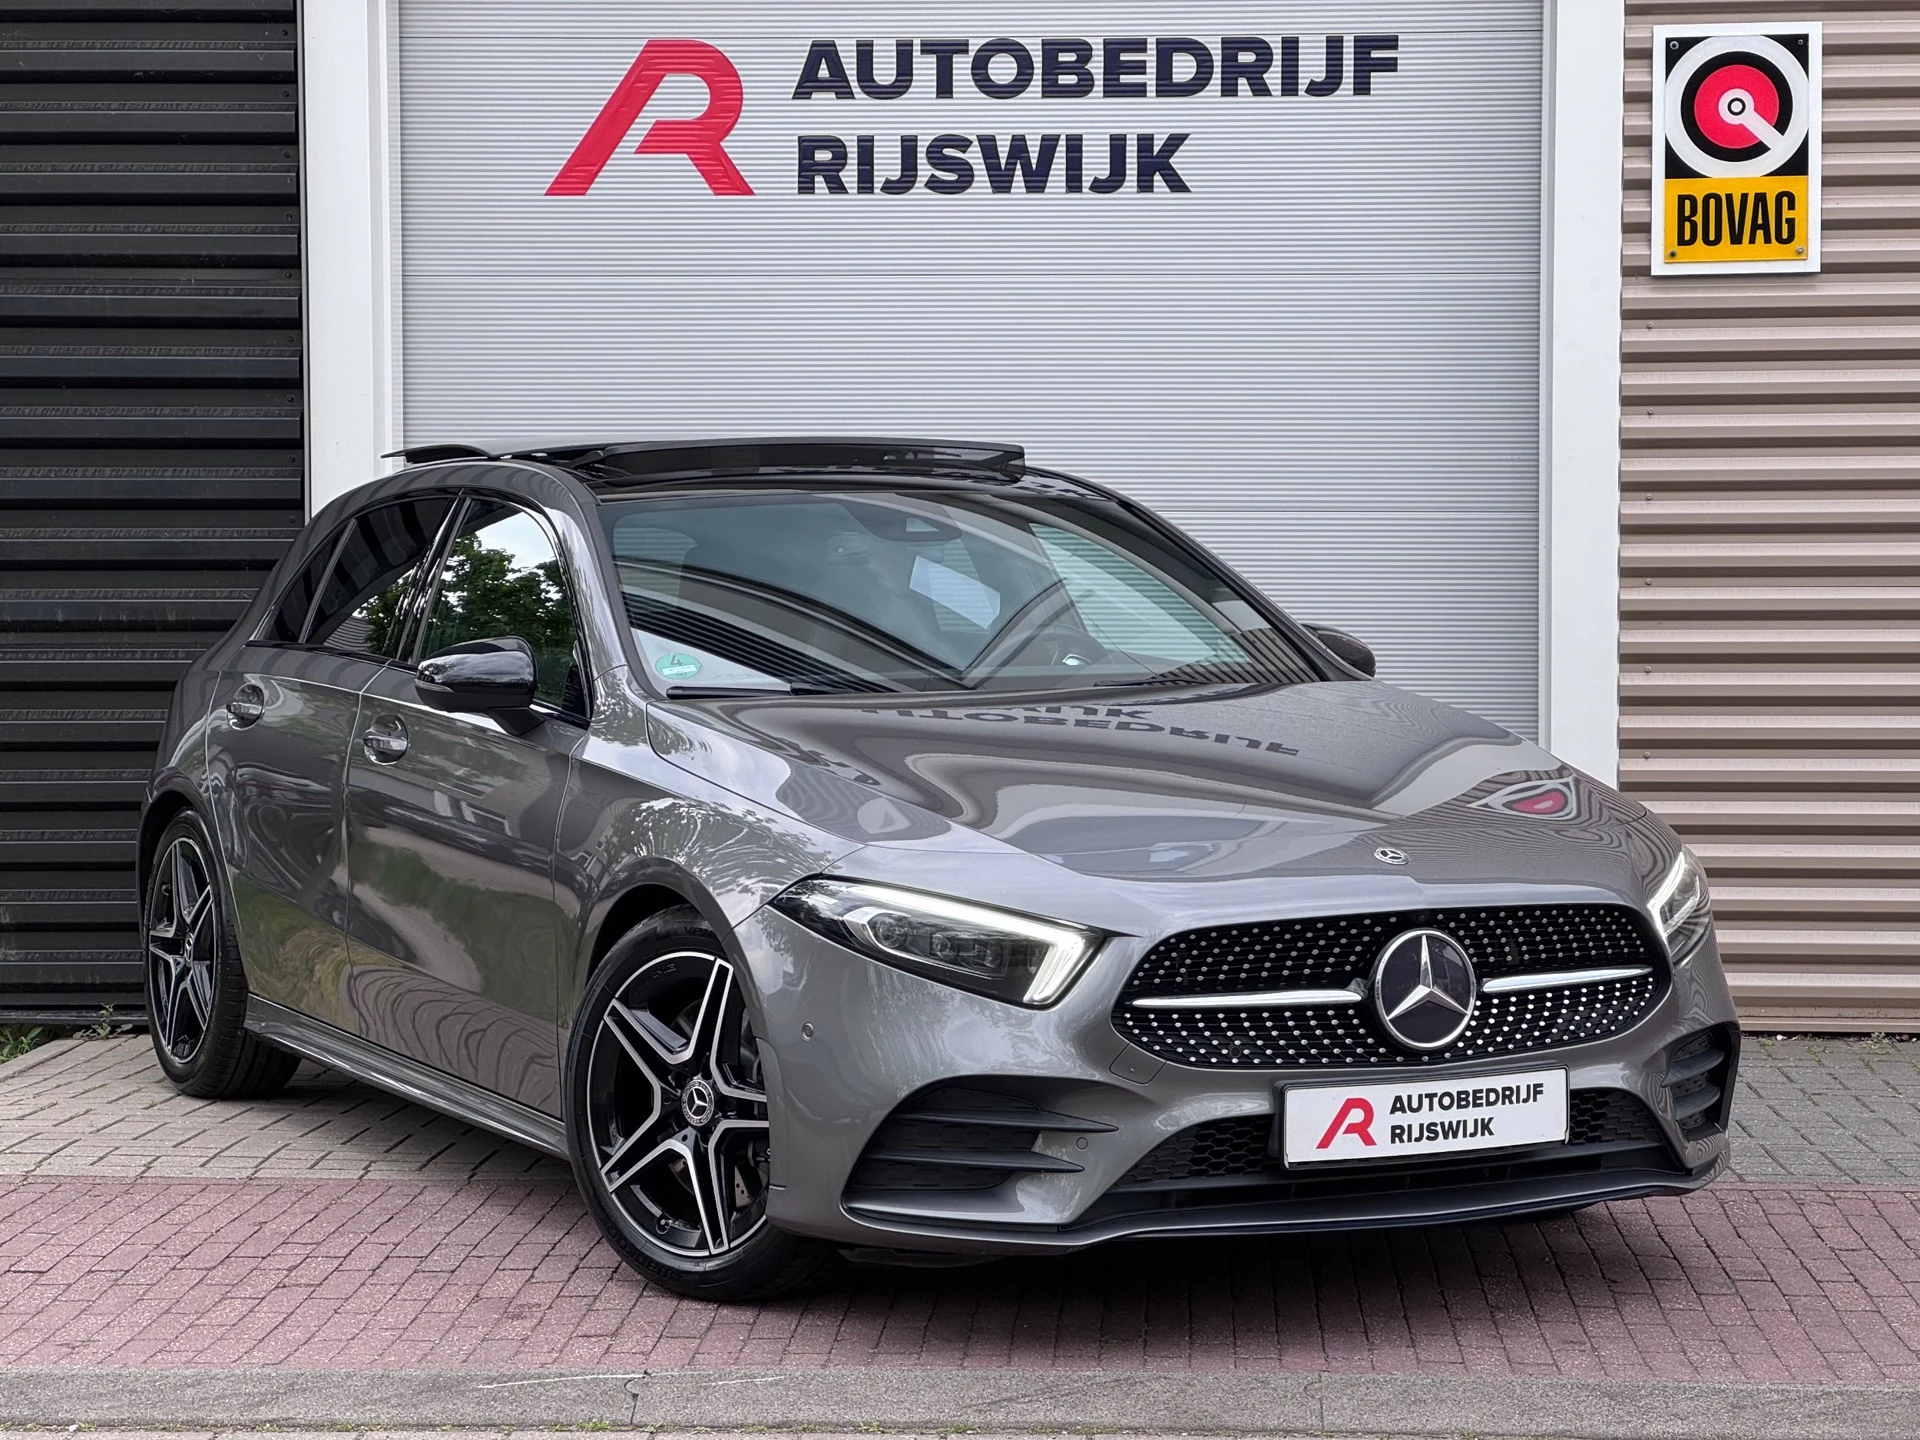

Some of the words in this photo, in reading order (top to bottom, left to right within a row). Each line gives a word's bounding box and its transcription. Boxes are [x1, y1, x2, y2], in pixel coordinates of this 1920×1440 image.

[792, 35, 1400, 99] AUTOBEDRIJF
[798, 134, 1192, 196] RIJSWIJK
[1677, 191, 1796, 247] BOVAG
[670, 655, 683, 666] 4
[1389, 1082, 1545, 1115] AUTOBEDRIJF
[1389, 1116, 1495, 1145] RIJSWIJK
